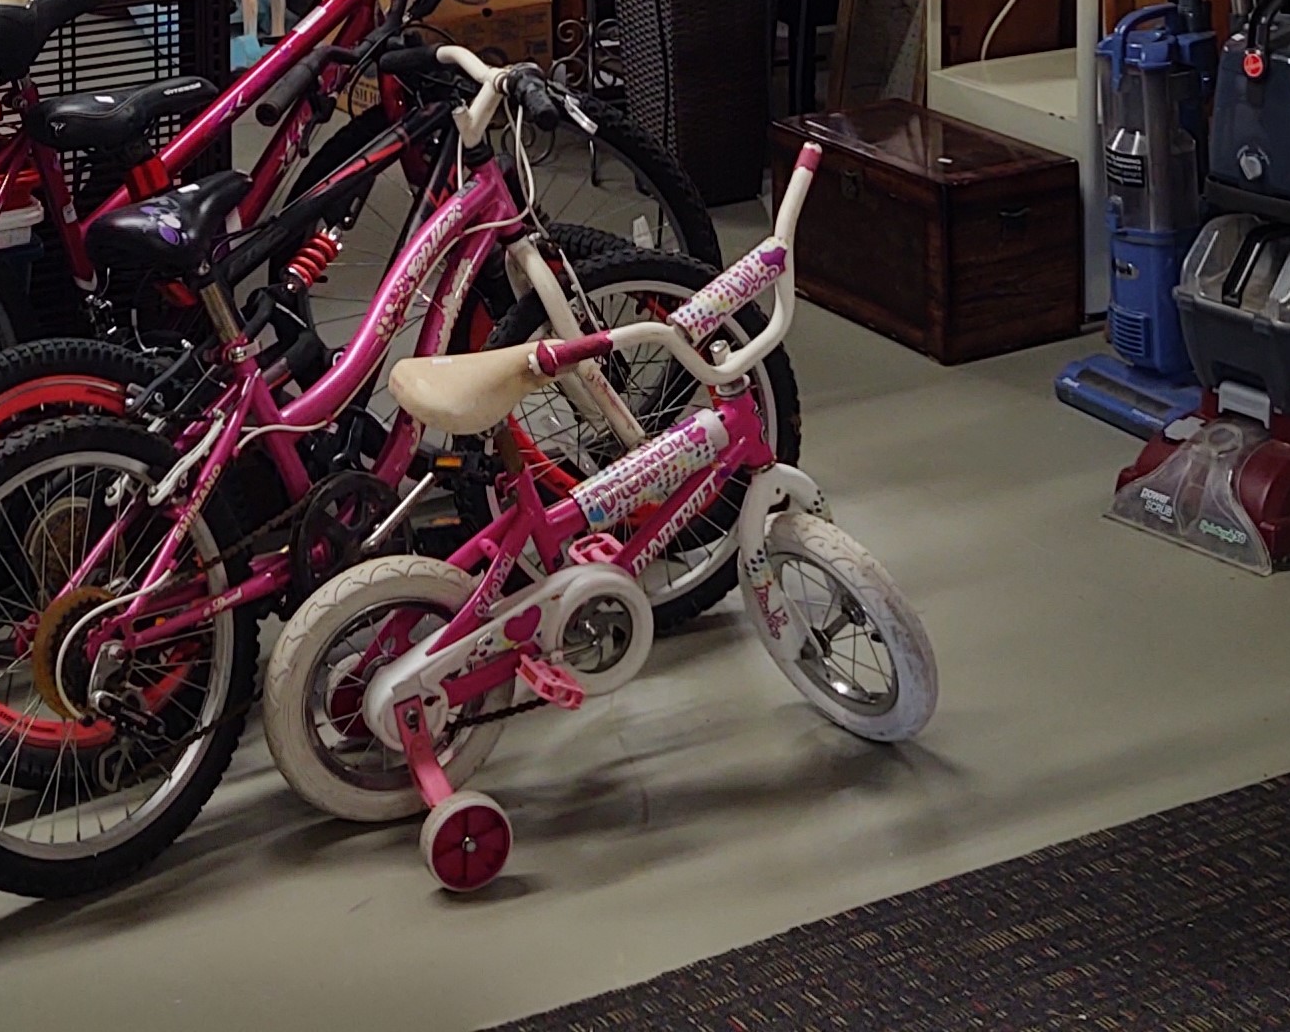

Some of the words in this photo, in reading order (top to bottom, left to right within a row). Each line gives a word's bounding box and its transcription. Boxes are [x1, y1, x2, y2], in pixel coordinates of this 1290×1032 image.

[1141, 487, 1171, 504] power
[1144, 499, 1173, 518] SCRUB
[631, 470, 718, 576] DYNACRAFT
